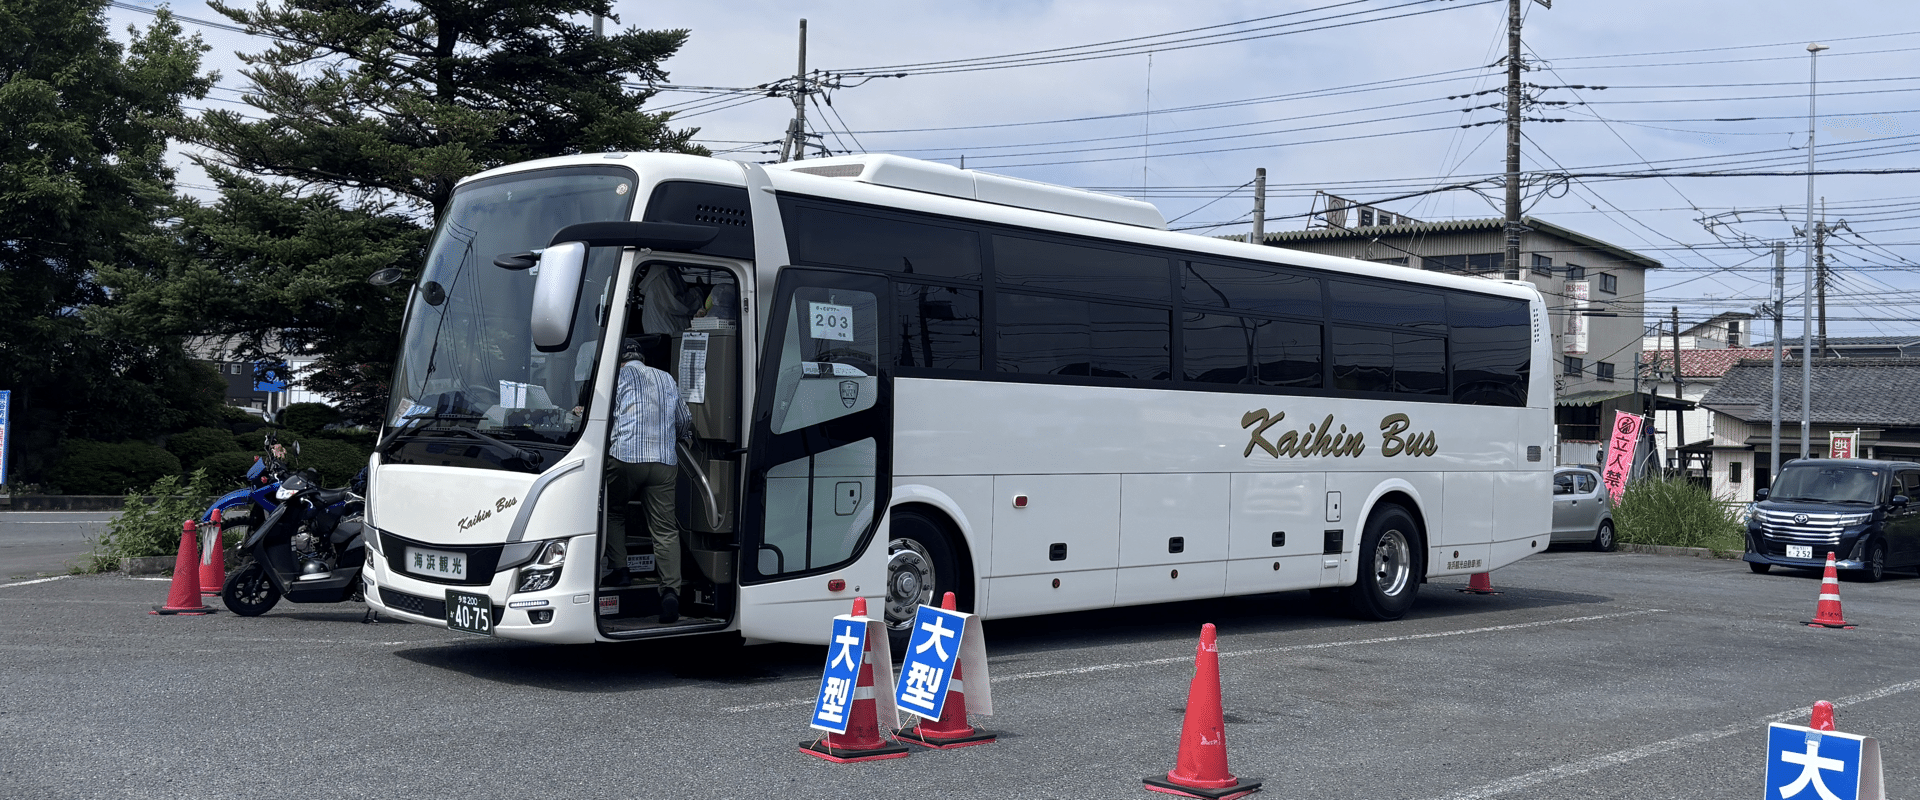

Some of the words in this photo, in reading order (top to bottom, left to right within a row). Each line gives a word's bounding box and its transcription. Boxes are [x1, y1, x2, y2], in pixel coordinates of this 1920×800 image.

[816, 314, 848, 329] 203
[1241, 408, 1365, 459] Kaihin
[1380, 412, 1438, 457] Bus
[457, 509, 492, 533] Kaihin
[495, 496, 517, 513] Bus
[413, 552, 462, 575] 海浜観光
[455, 604, 489, 631] 40-75
[817, 625, 859, 723] 大型
[901, 616, 955, 711] 大型
[1779, 739, 1844, 800] 大
